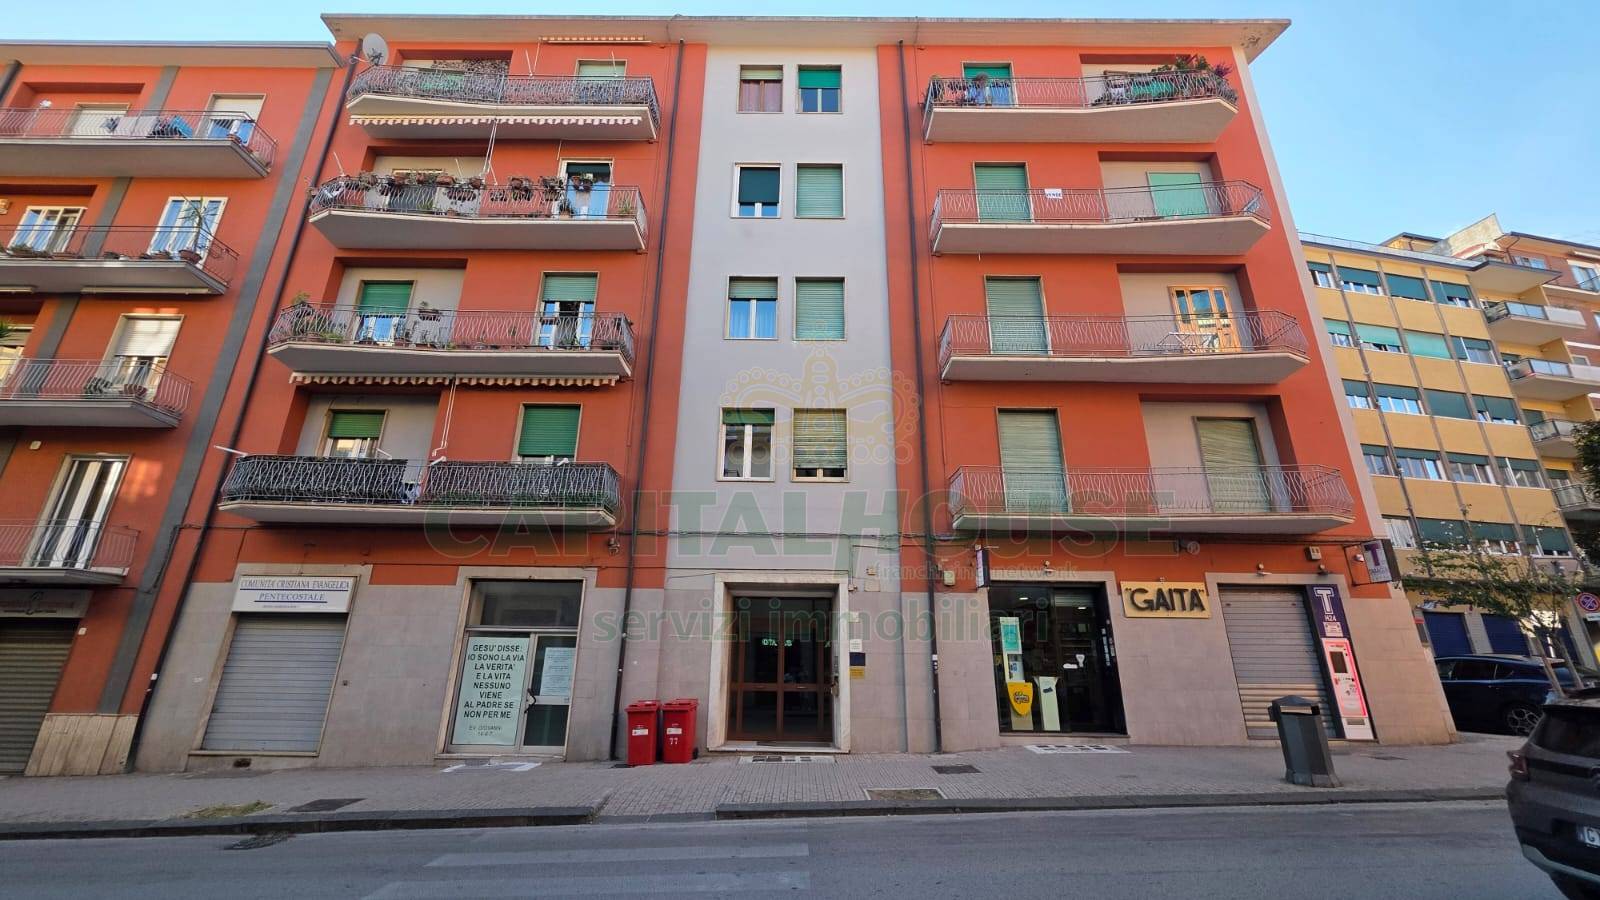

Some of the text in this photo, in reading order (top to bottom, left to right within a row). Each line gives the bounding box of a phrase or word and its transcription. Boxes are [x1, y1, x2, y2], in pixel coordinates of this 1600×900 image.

[259, 592, 326, 601] PENTECOSTALE
[1313, 587, 1334, 614] T
[474, 663, 486, 671] LA
[476, 672, 511, 680] E LA VITA
[479, 691, 502, 699] VIENE
[464, 701, 514, 709] AL PADRE SE
[463, 710, 511, 719] NON PER ME
